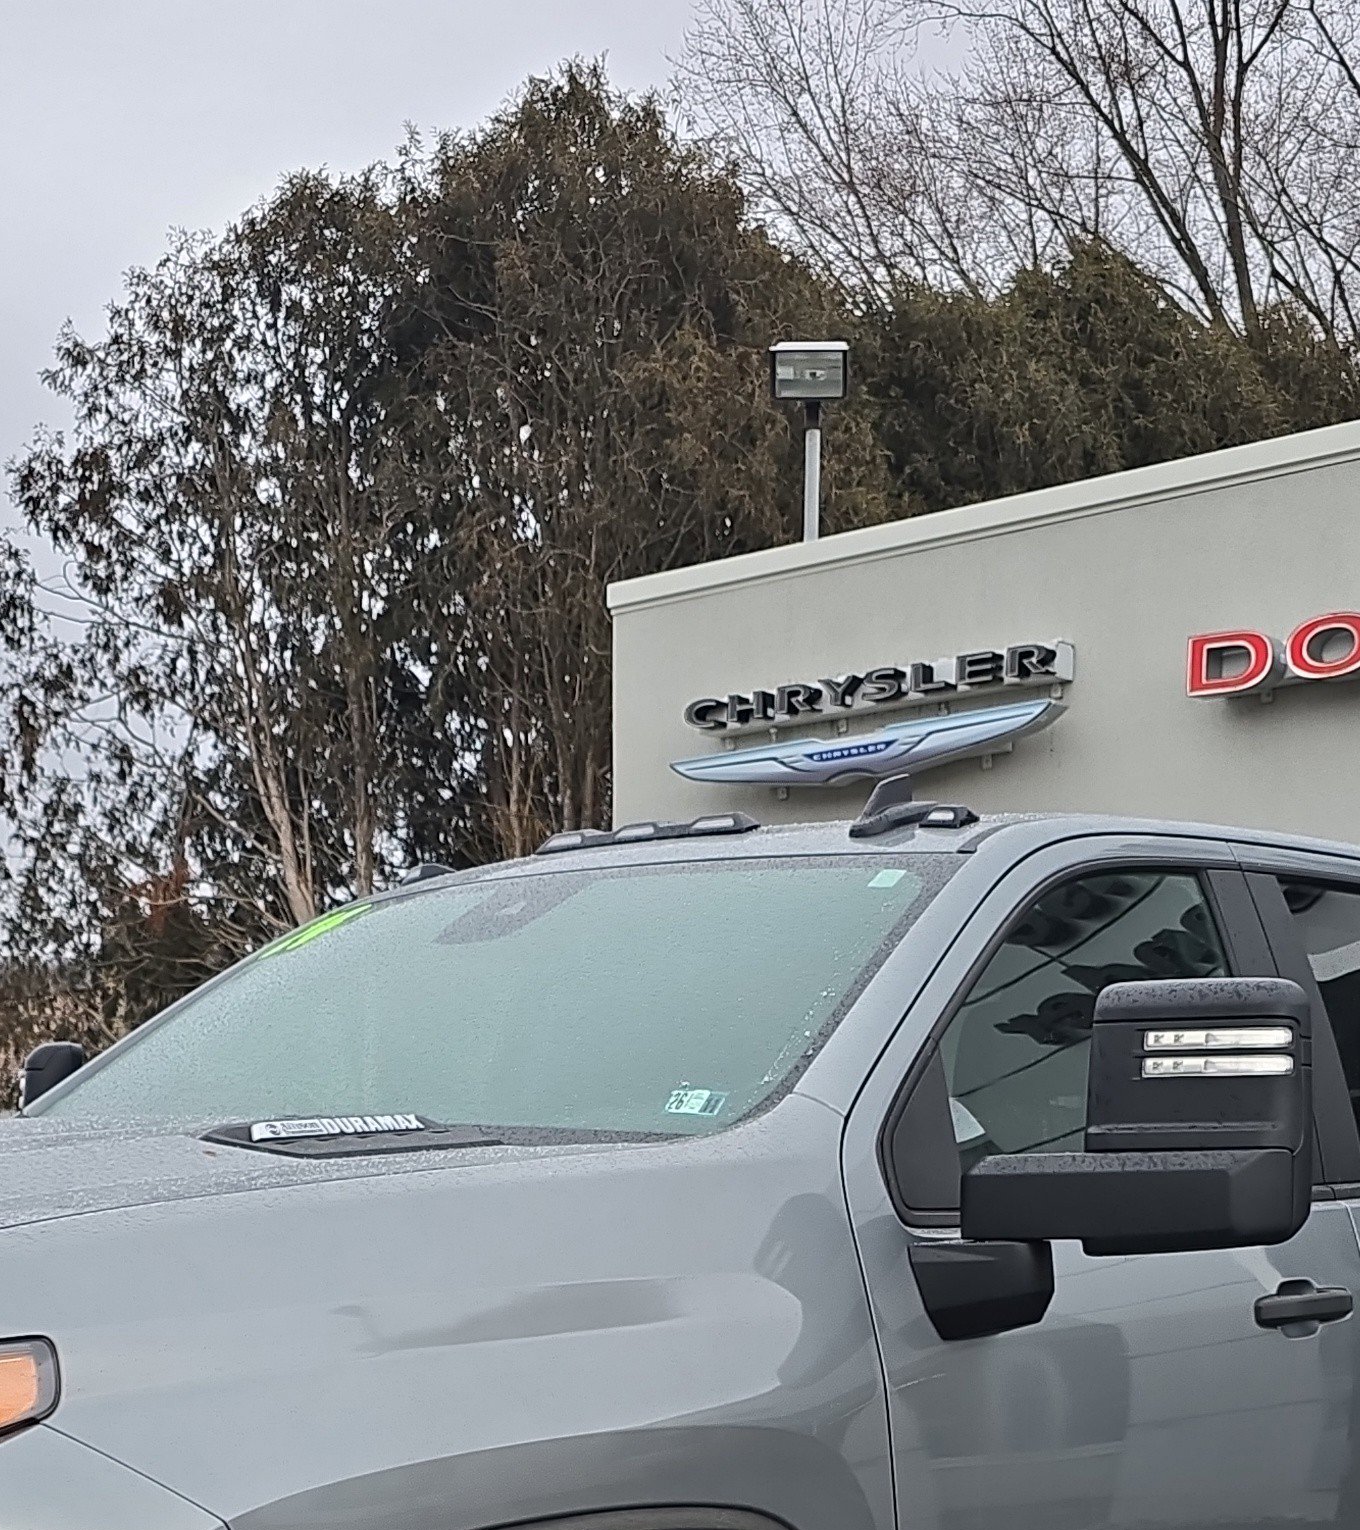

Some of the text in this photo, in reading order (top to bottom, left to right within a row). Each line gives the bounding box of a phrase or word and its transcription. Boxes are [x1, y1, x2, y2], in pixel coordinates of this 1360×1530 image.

[684, 643, 1056, 729] CHRYSLER
[813, 744, 886, 760] CHRYSLER
[320, 1114, 425, 1134] DURAMAX
